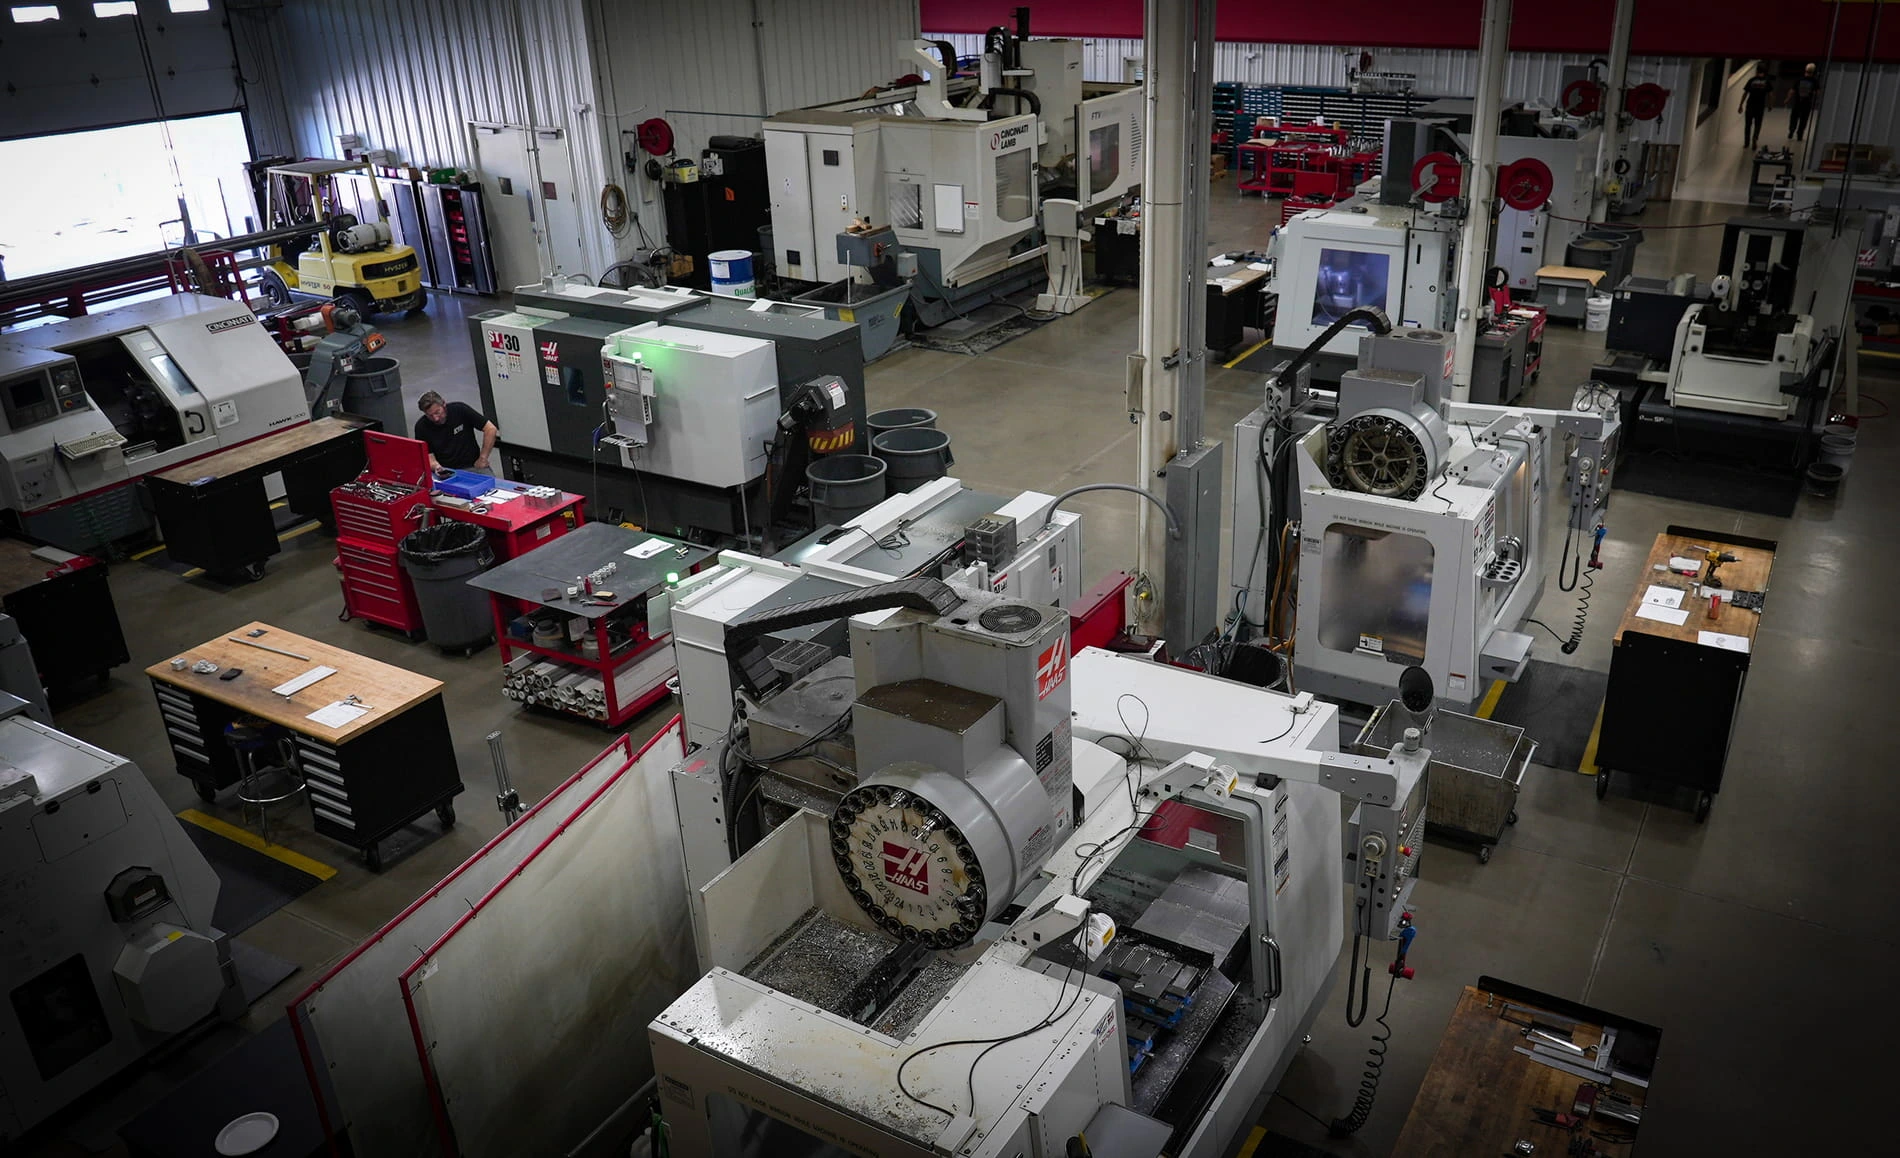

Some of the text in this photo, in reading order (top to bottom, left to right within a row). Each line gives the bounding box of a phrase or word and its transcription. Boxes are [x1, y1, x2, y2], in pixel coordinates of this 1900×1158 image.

[301, 280, 321, 288] HYSTER
[208, 316, 252, 331] CINCINNATI
[504, 334, 520, 352] 30
[1039, 665, 1066, 698] HAAS
[884, 871, 928, 892] HAAS
[895, 897, 904, 909] 24
